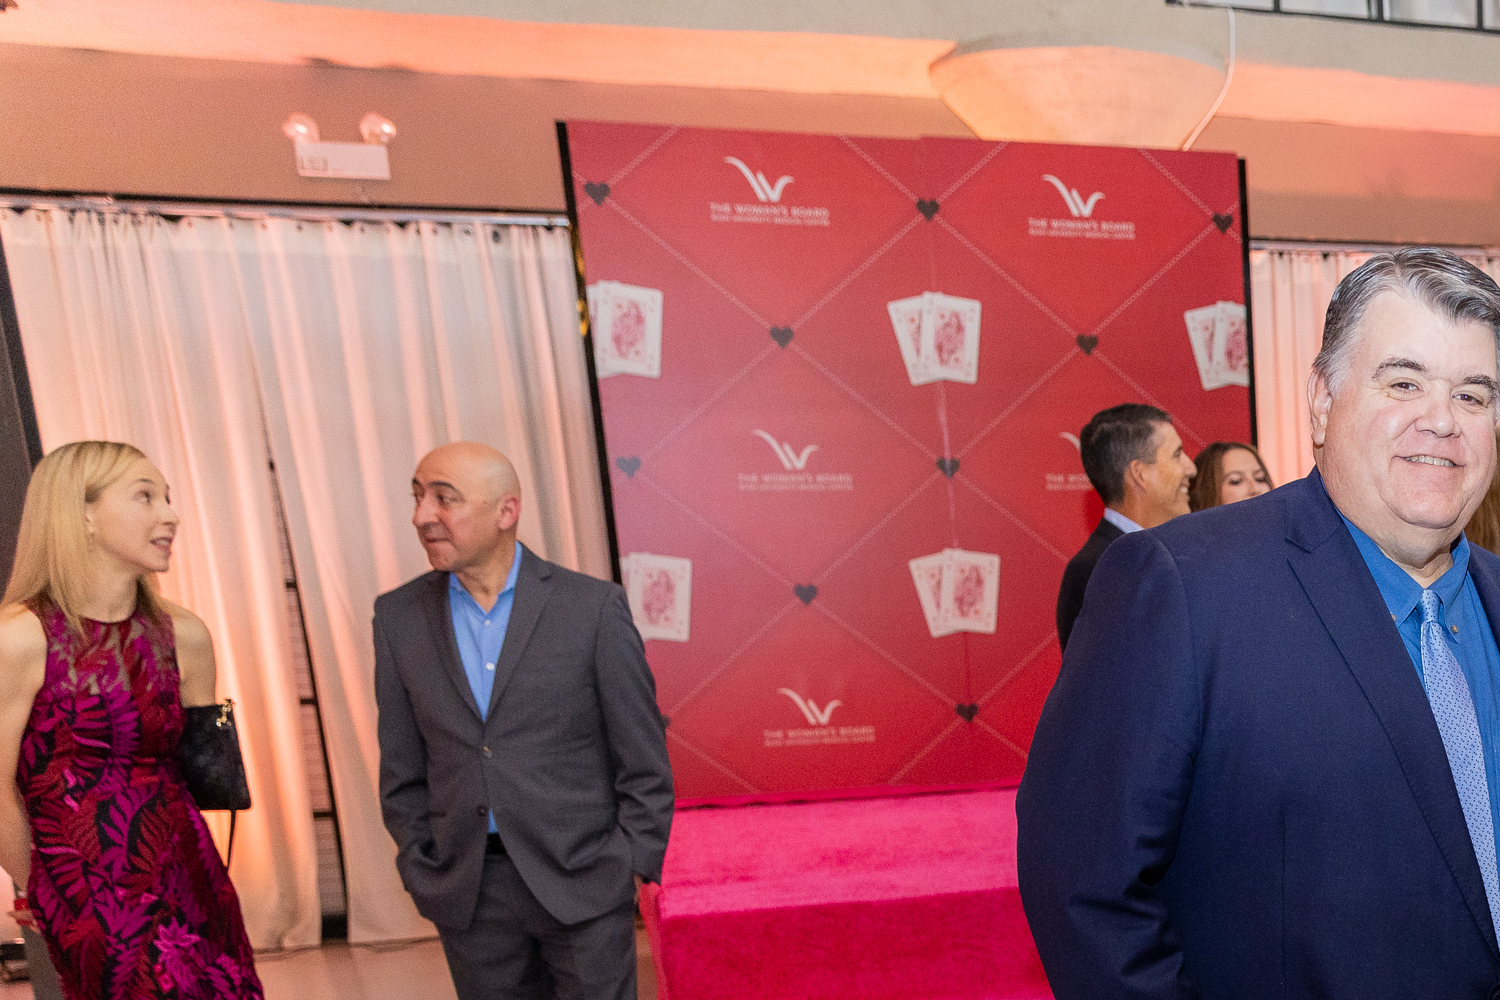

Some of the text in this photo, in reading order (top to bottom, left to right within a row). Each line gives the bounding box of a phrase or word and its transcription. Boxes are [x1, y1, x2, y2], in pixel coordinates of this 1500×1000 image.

[710, 202, 731, 213] THE
[790, 206, 830, 218] BOARD
[1028, 217, 1047, 228] THE
